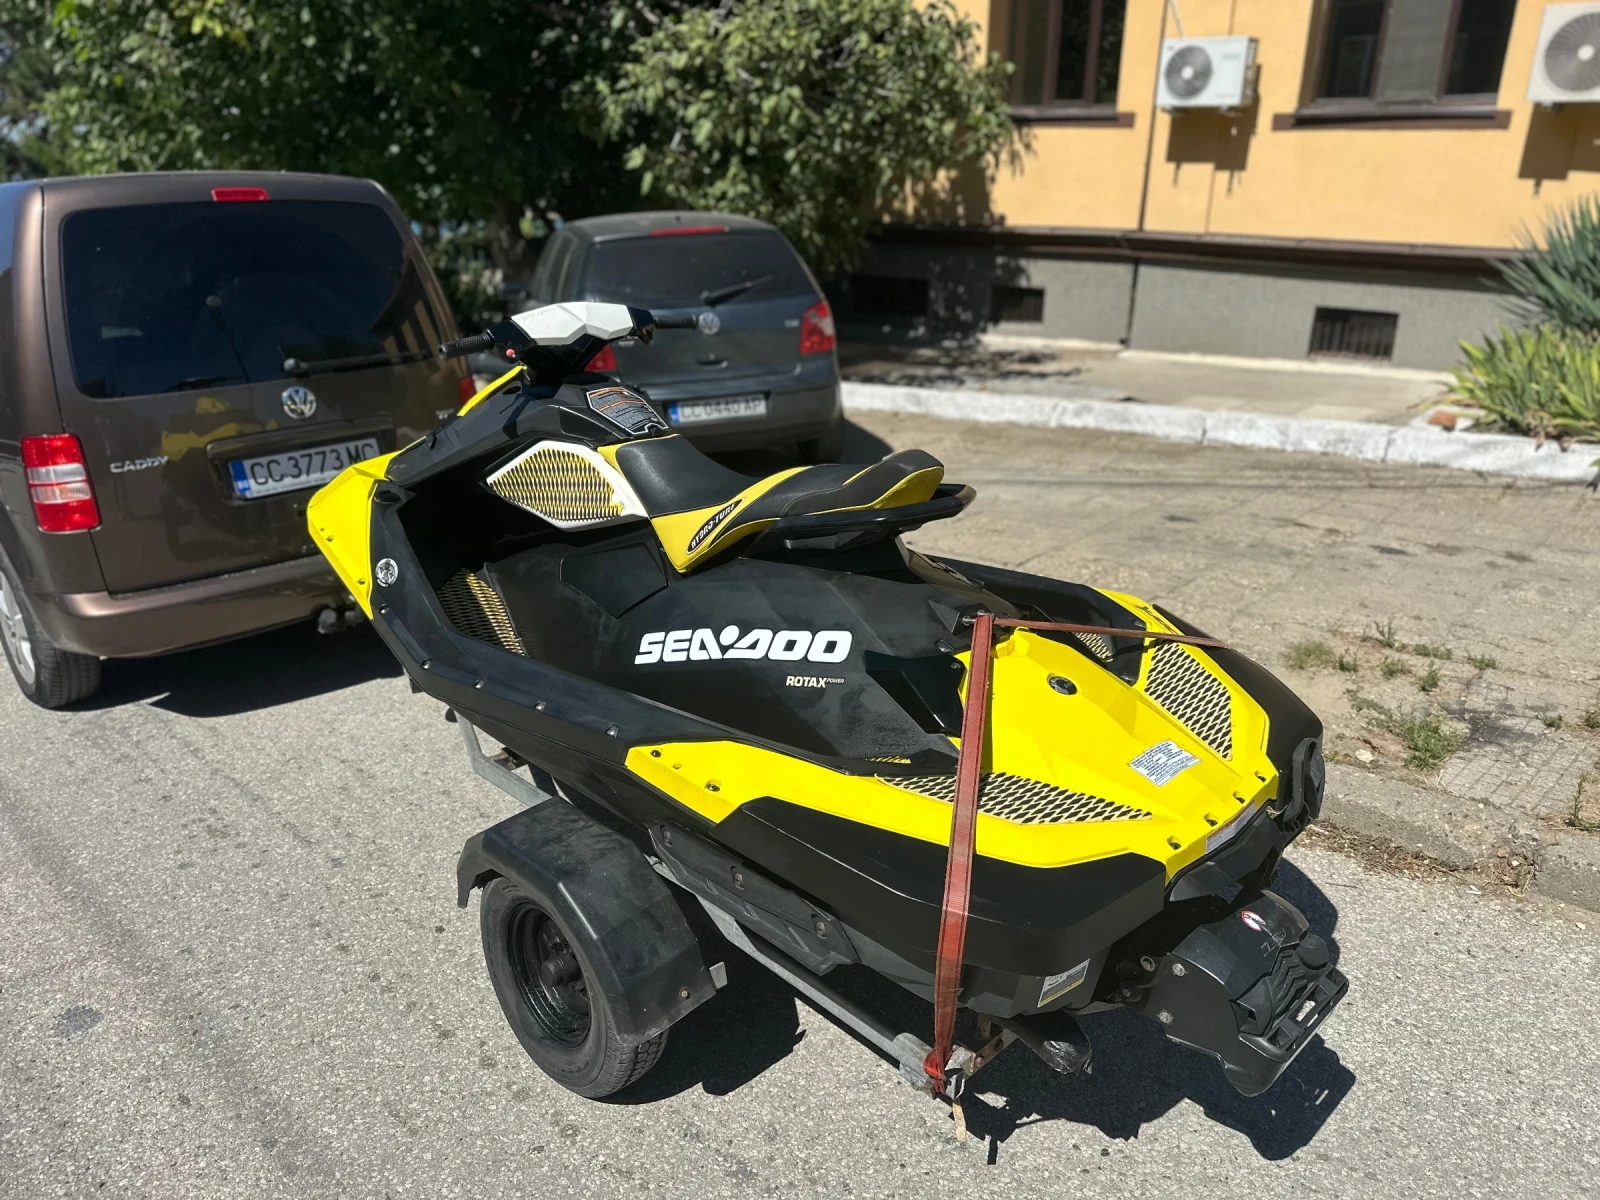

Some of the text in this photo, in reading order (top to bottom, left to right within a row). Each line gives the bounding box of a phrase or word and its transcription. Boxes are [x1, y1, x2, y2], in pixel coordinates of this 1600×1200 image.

[110, 455, 169, 473] CADDY
[250, 459, 285, 486] CC
[287, 449, 344, 478] 3773
[785, 675, 828, 689] ROTAX
